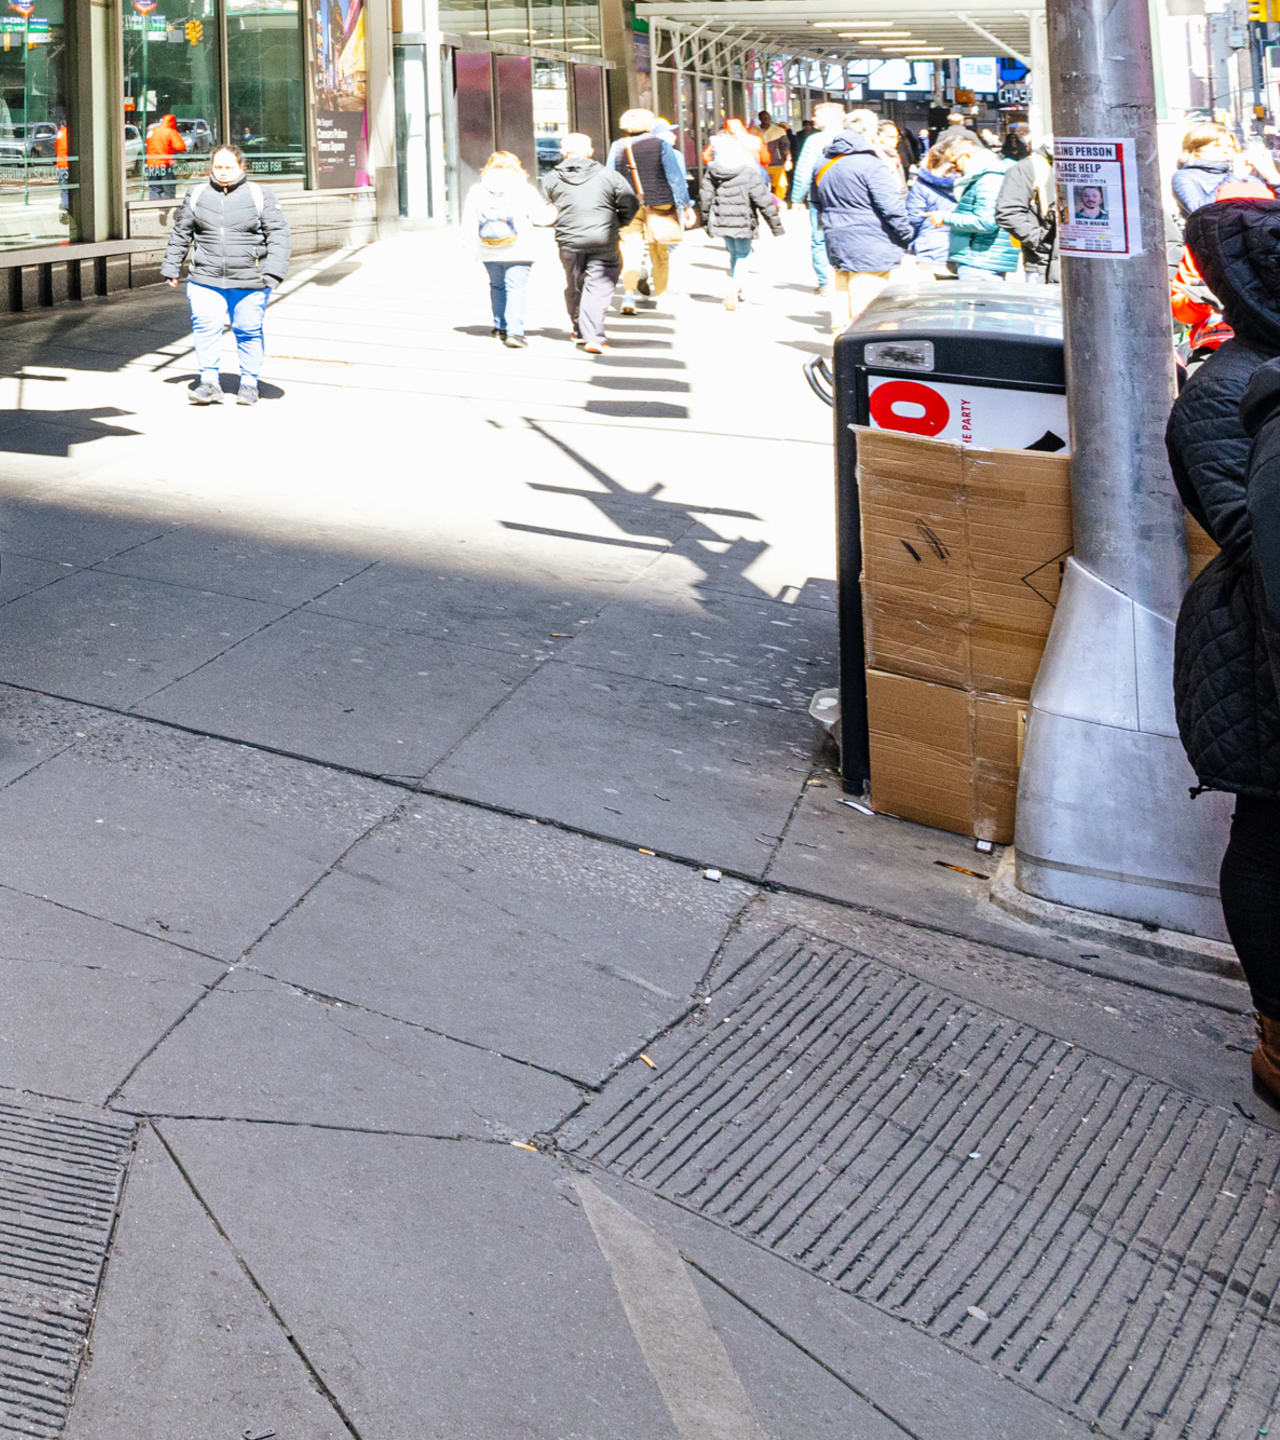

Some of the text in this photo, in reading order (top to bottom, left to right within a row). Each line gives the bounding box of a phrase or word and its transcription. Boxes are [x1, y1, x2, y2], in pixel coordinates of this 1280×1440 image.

[1076, 146, 1113, 157] PERSON
[143, 163, 166, 177] CRAB
[251, 161, 282, 172] FRESH FISH
[1078, 163, 1102, 173] HELP
[961, 399, 973, 431] PARTY
